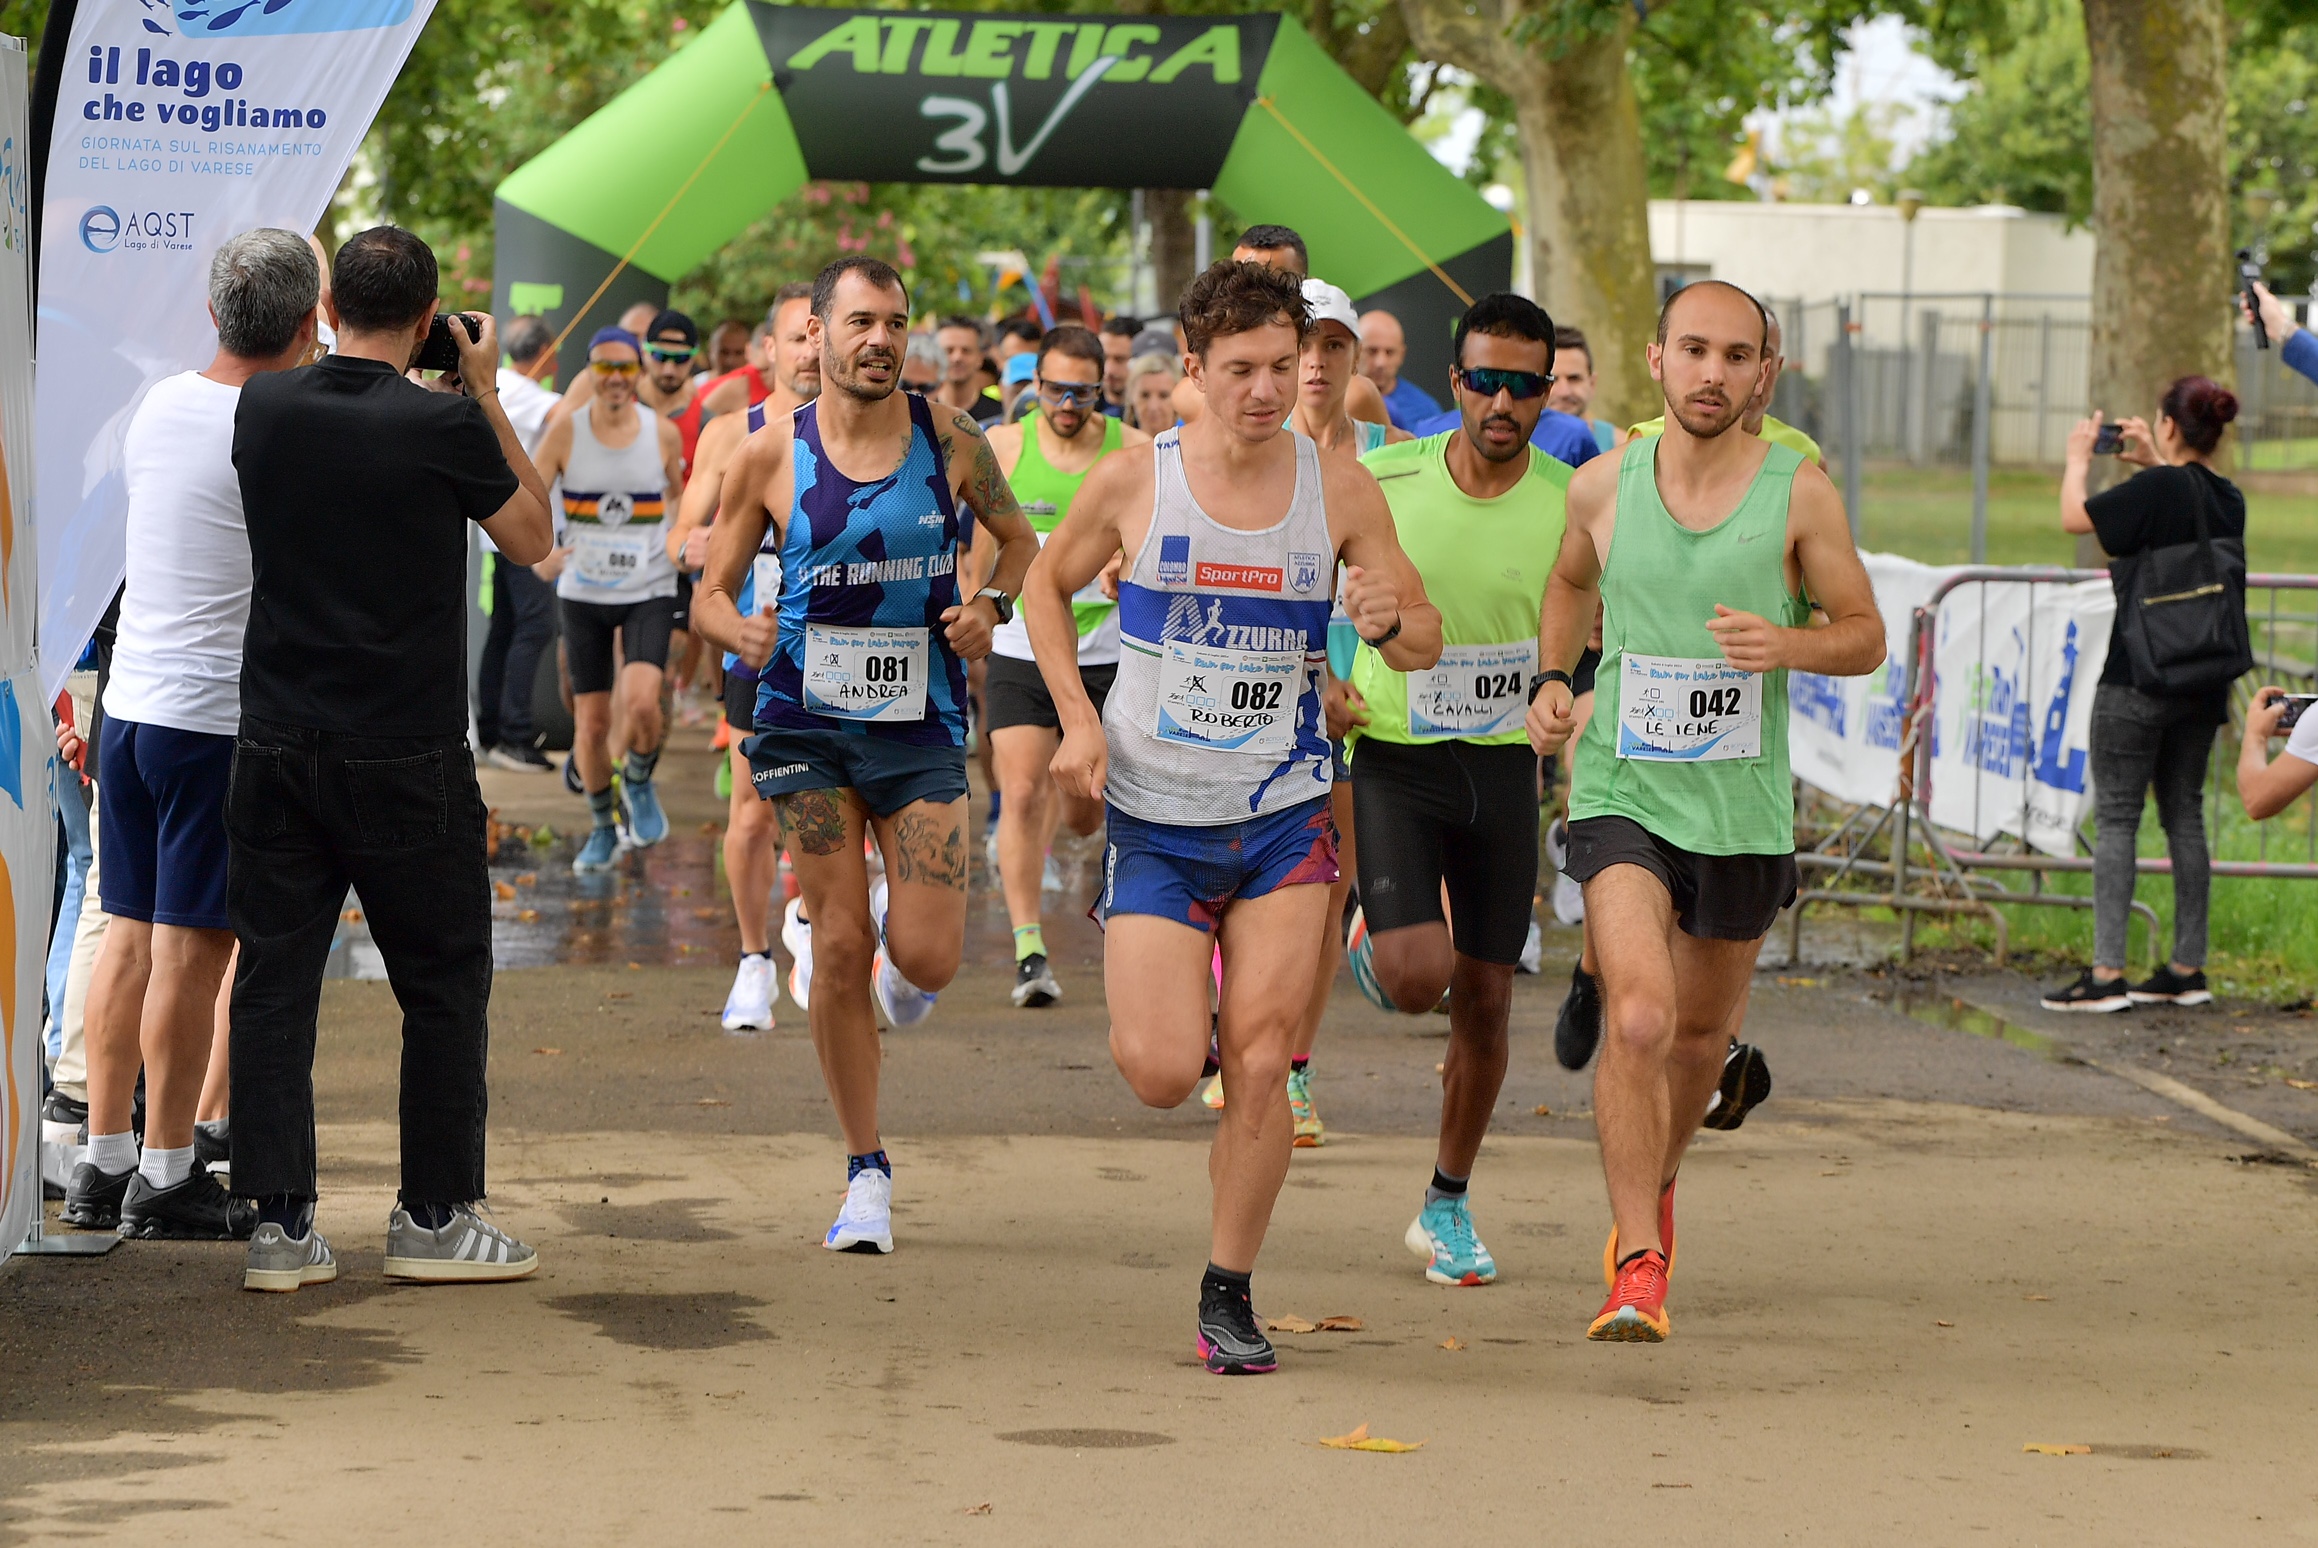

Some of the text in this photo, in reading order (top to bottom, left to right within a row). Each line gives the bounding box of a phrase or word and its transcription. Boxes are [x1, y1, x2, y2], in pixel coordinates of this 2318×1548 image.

[788, 15, 1242, 84] ATLETICA
[88, 45, 243, 98] il lago
[83, 93, 327, 132] che vogliamo
[917, 55, 1125, 176] 3V
[81, 137, 322, 156] GIORNATA SUL RISANAMENTO
[79, 157, 254, 175] DEL LAGO DI VARESE
[125, 212, 195, 239] AQST
[125, 239, 193, 251] Lago di Varese
[812, 564, 841, 587] THE
[847, 556, 924, 586] RUNNING
[1200, 567, 1279, 585] SportPro
[865, 655, 909, 682] 081
[839, 684, 908, 699] ANDREA
[1231, 681, 1283, 711] 082
[1475, 672, 1521, 700] 024
[1433, 703, 1493, 717] CAVALLI
[1689, 687, 1741, 719] 042
[1646, 720, 1720, 736] LE IENE
[751, 762, 809, 784] SOFFIENTINI
